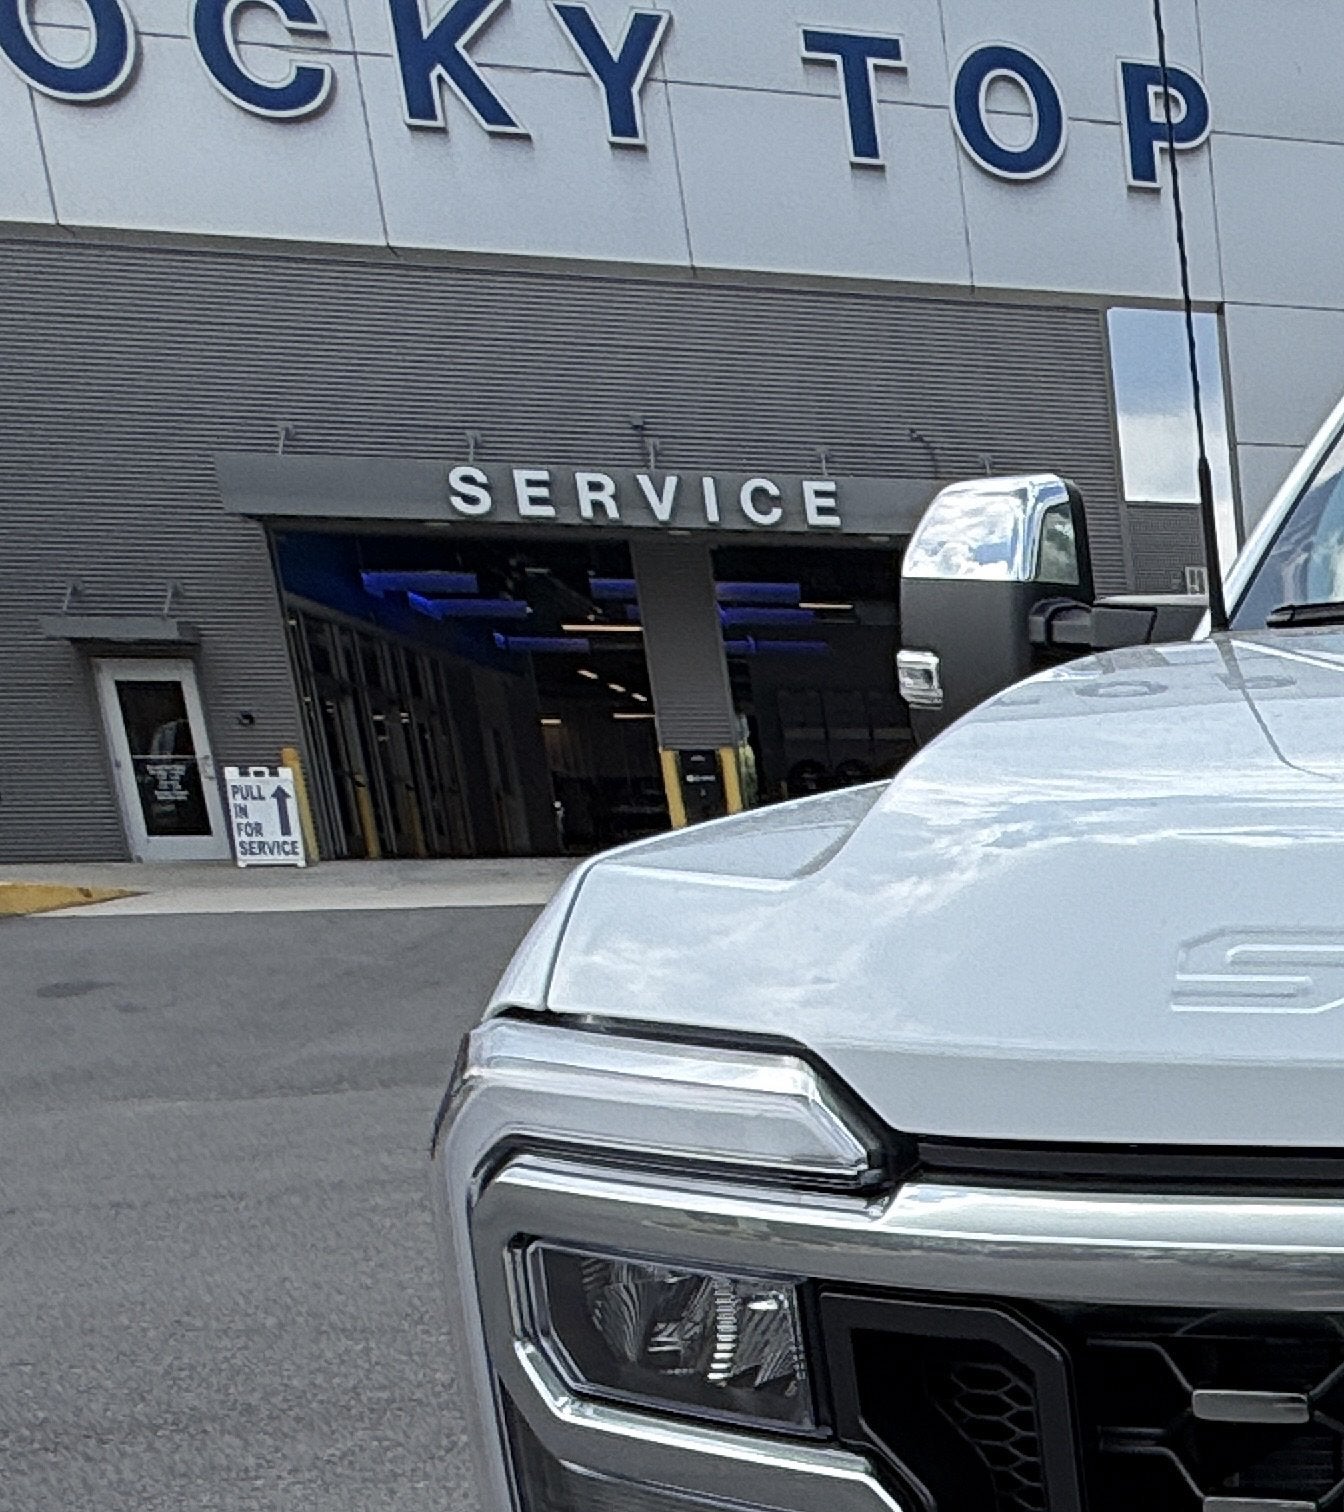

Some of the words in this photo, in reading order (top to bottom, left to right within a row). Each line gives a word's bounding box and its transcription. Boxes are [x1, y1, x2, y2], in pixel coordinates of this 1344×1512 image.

[800, 26, 1211, 187] TOP
[447, 466, 842, 527] SERVICE
[230, 784, 266, 801] PULL
[233, 803, 249, 819] IN
[236, 821, 264, 838] FOR
[238, 840, 300, 856] SERVICE
